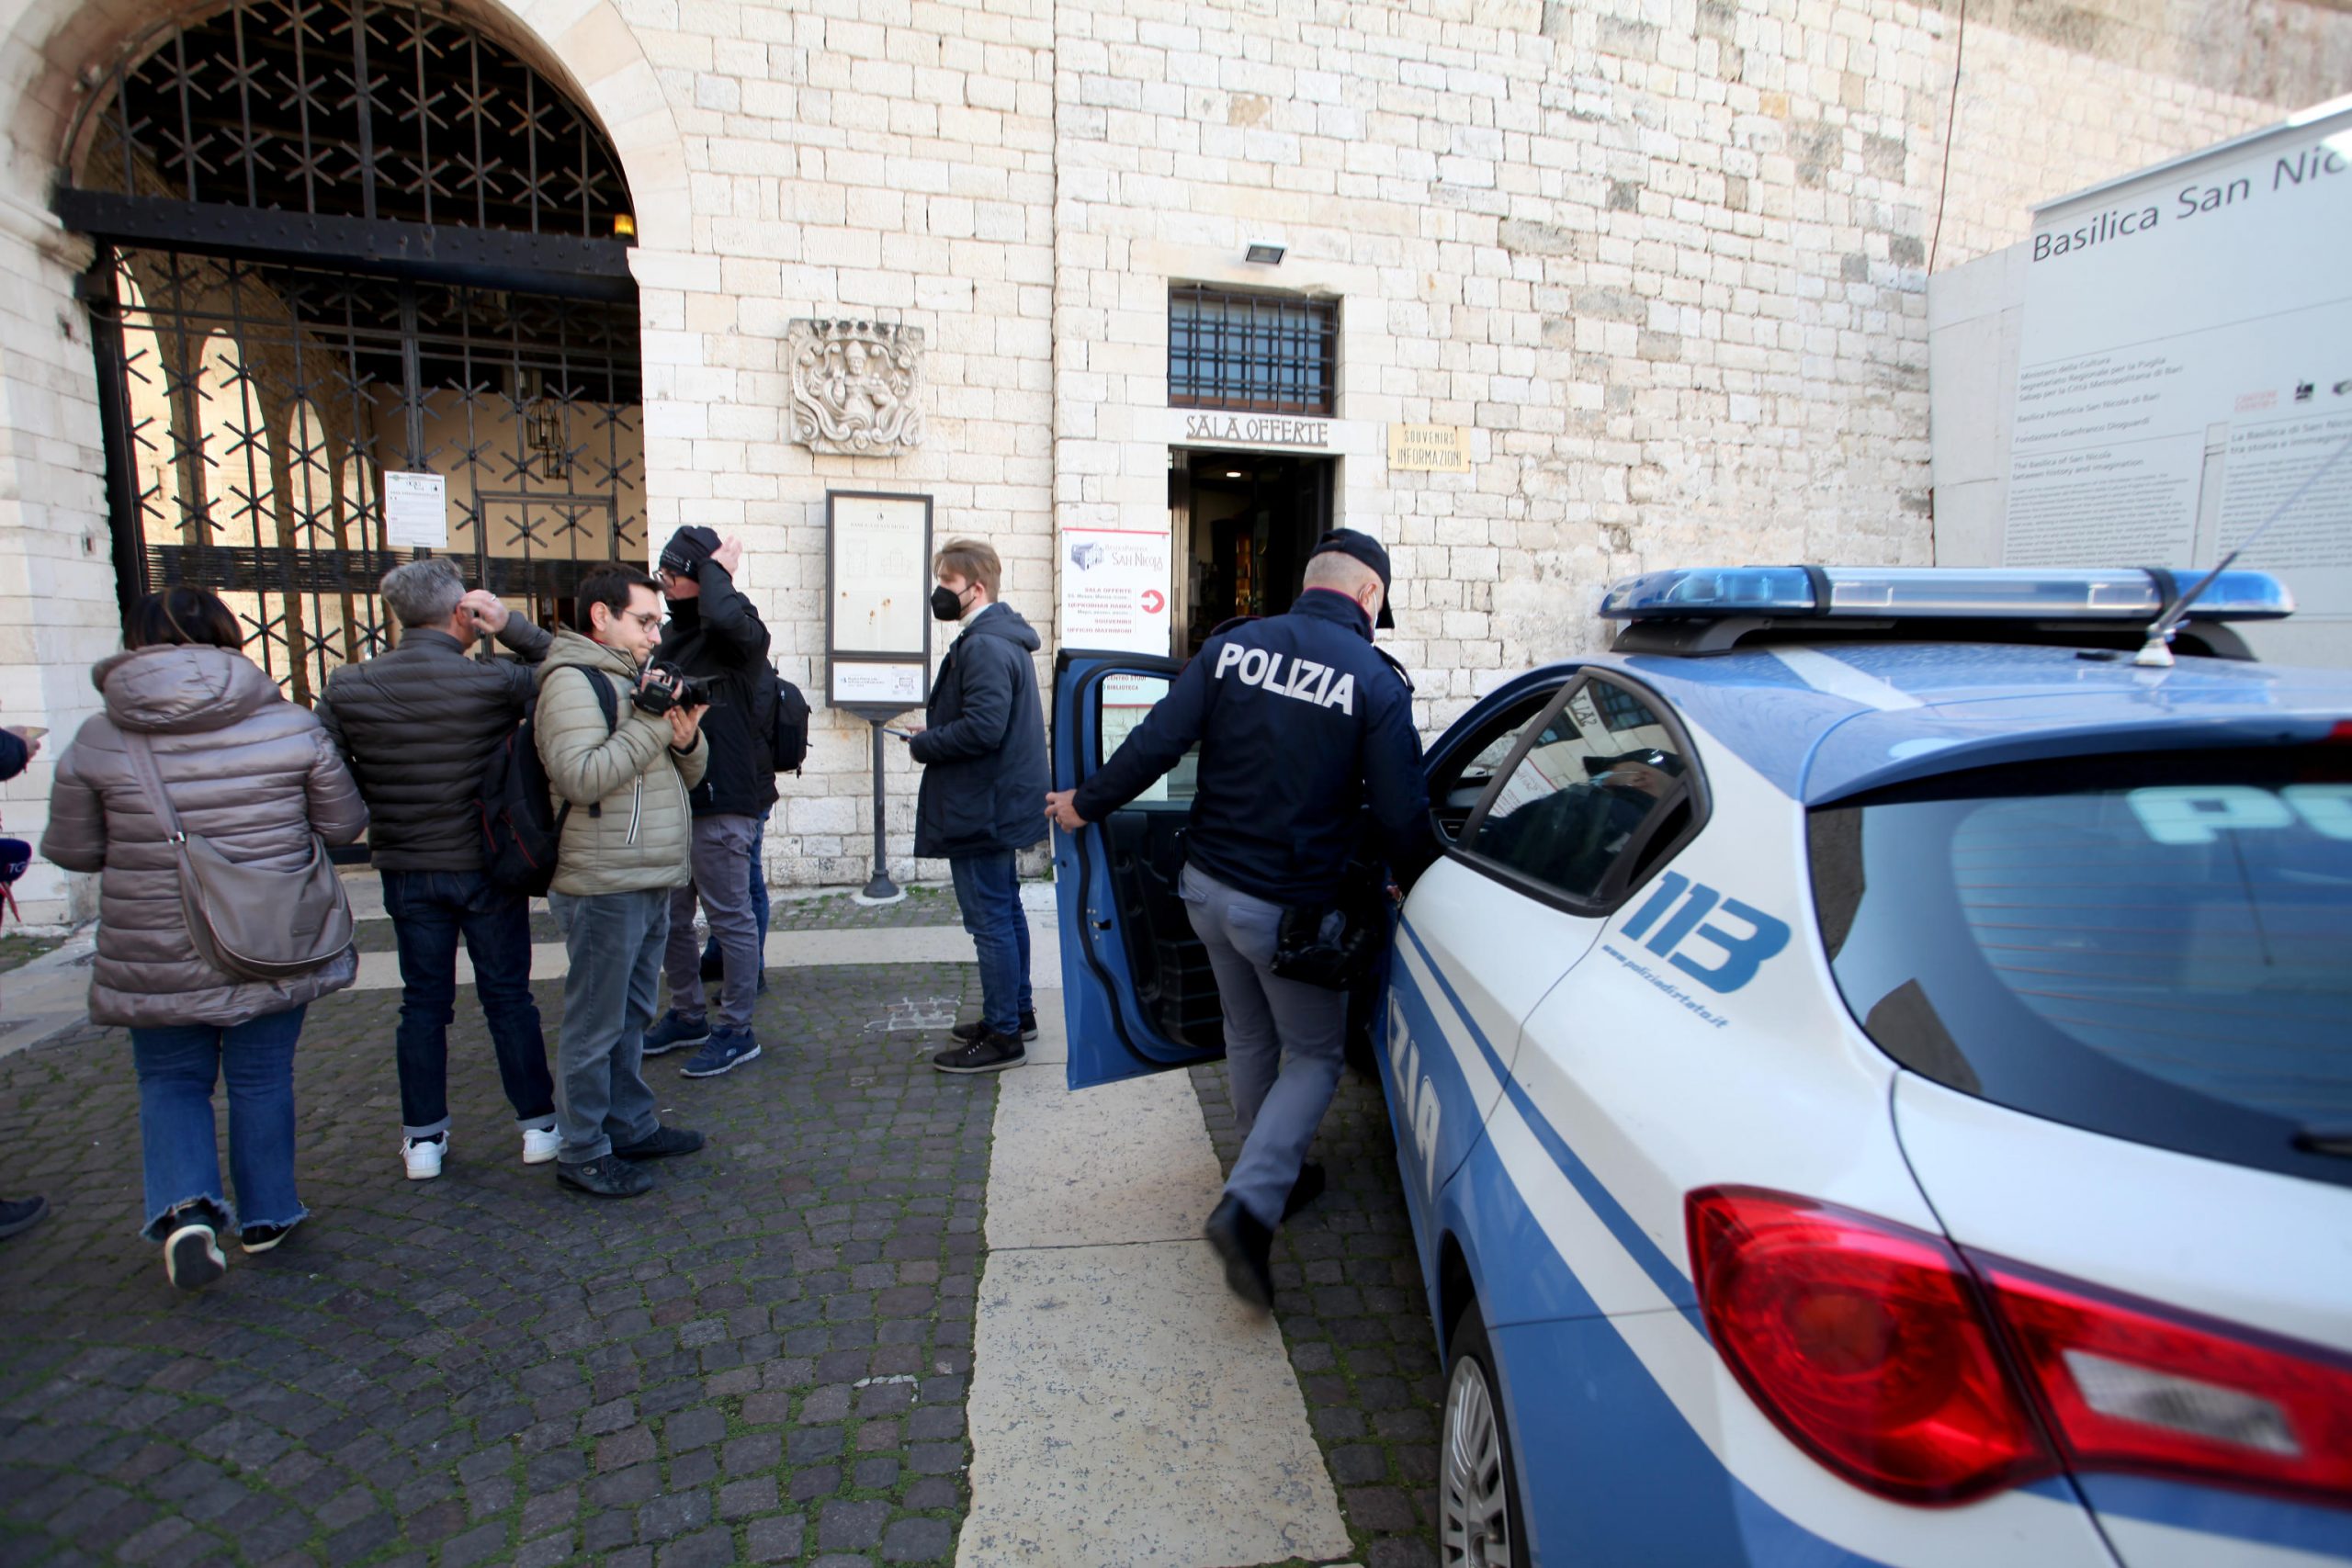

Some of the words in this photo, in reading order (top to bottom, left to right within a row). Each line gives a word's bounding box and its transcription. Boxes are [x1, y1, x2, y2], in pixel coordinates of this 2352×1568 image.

[2033, 207, 2158, 262] Basilica
[2177, 177, 2249, 220] San
[1186, 415, 1241, 440] SALA
[1247, 418, 1329, 447] OFFERTE
[1397, 447, 1462, 468] INFORMAZIONI
[1404, 429, 1454, 446] SOUVENIRS
[1112, 552, 1132, 567] SAN
[1215, 642, 1354, 716] POLIZIA
[1619, 870, 1791, 994] 113
[1601, 944, 1729, 1029] www.poliziadistato.it
